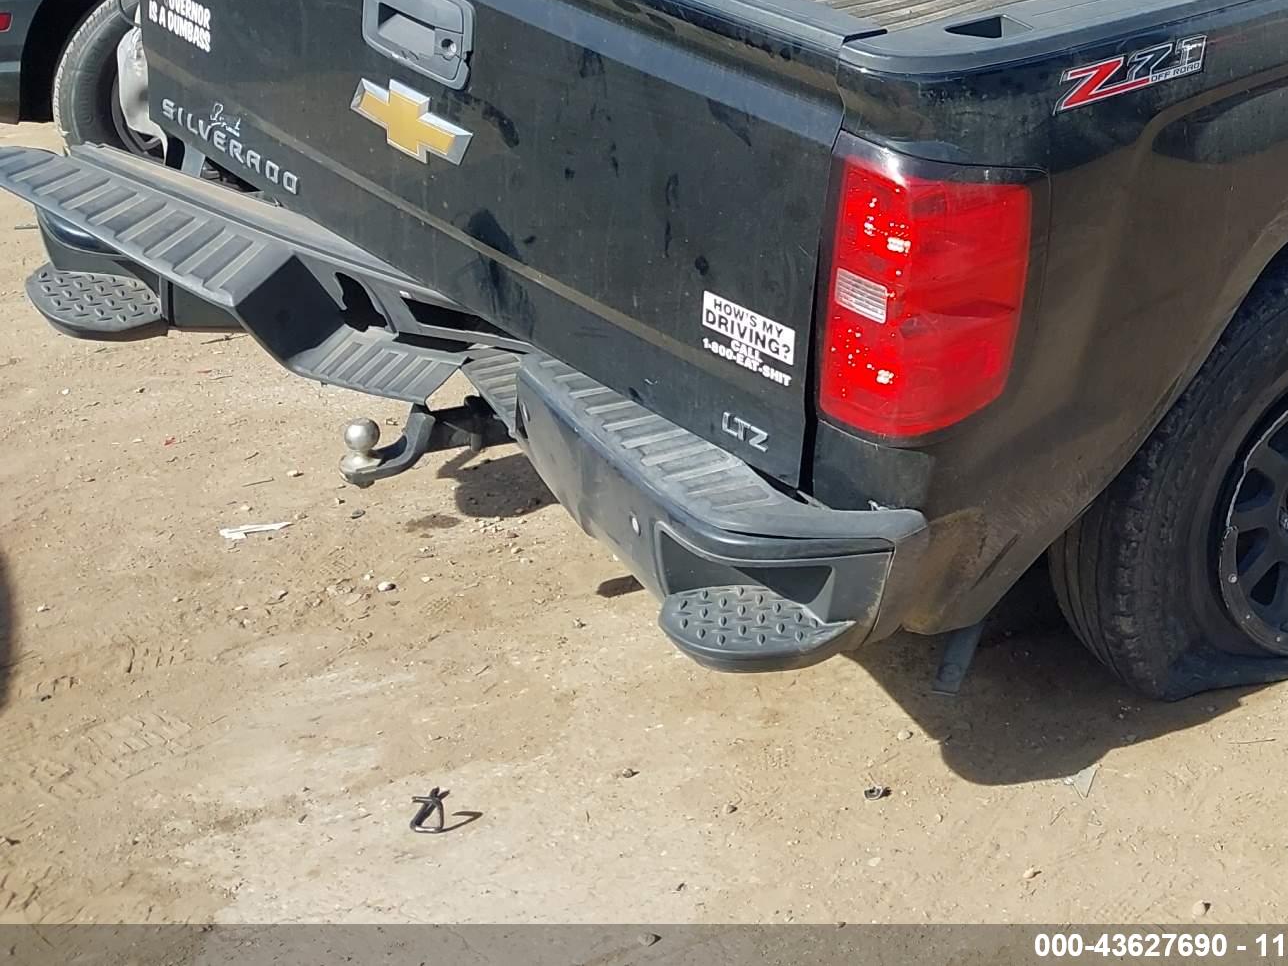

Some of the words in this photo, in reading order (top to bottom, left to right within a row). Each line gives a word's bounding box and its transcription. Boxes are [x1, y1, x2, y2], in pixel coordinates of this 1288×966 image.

[148, 0, 158, 23] IS
[158, 5, 167, 28] A
[167, 9, 211, 53] DUMBASS
[1055, 34, 1207, 114] Z71
[1151, 70, 1173, 82] OFF
[1173, 61, 1201, 76] ROAD
[162, 98, 299, 195] SILVERADO
[705, 308, 791, 359] DRIVING?
[713, 298, 757, 327] HOW'S
[762, 320, 784, 338] MY
[702, 337, 792, 387] 1-800-EAT-SHIT
[730, 339, 763, 363] CALL
[721, 411, 769, 453] LTZ
